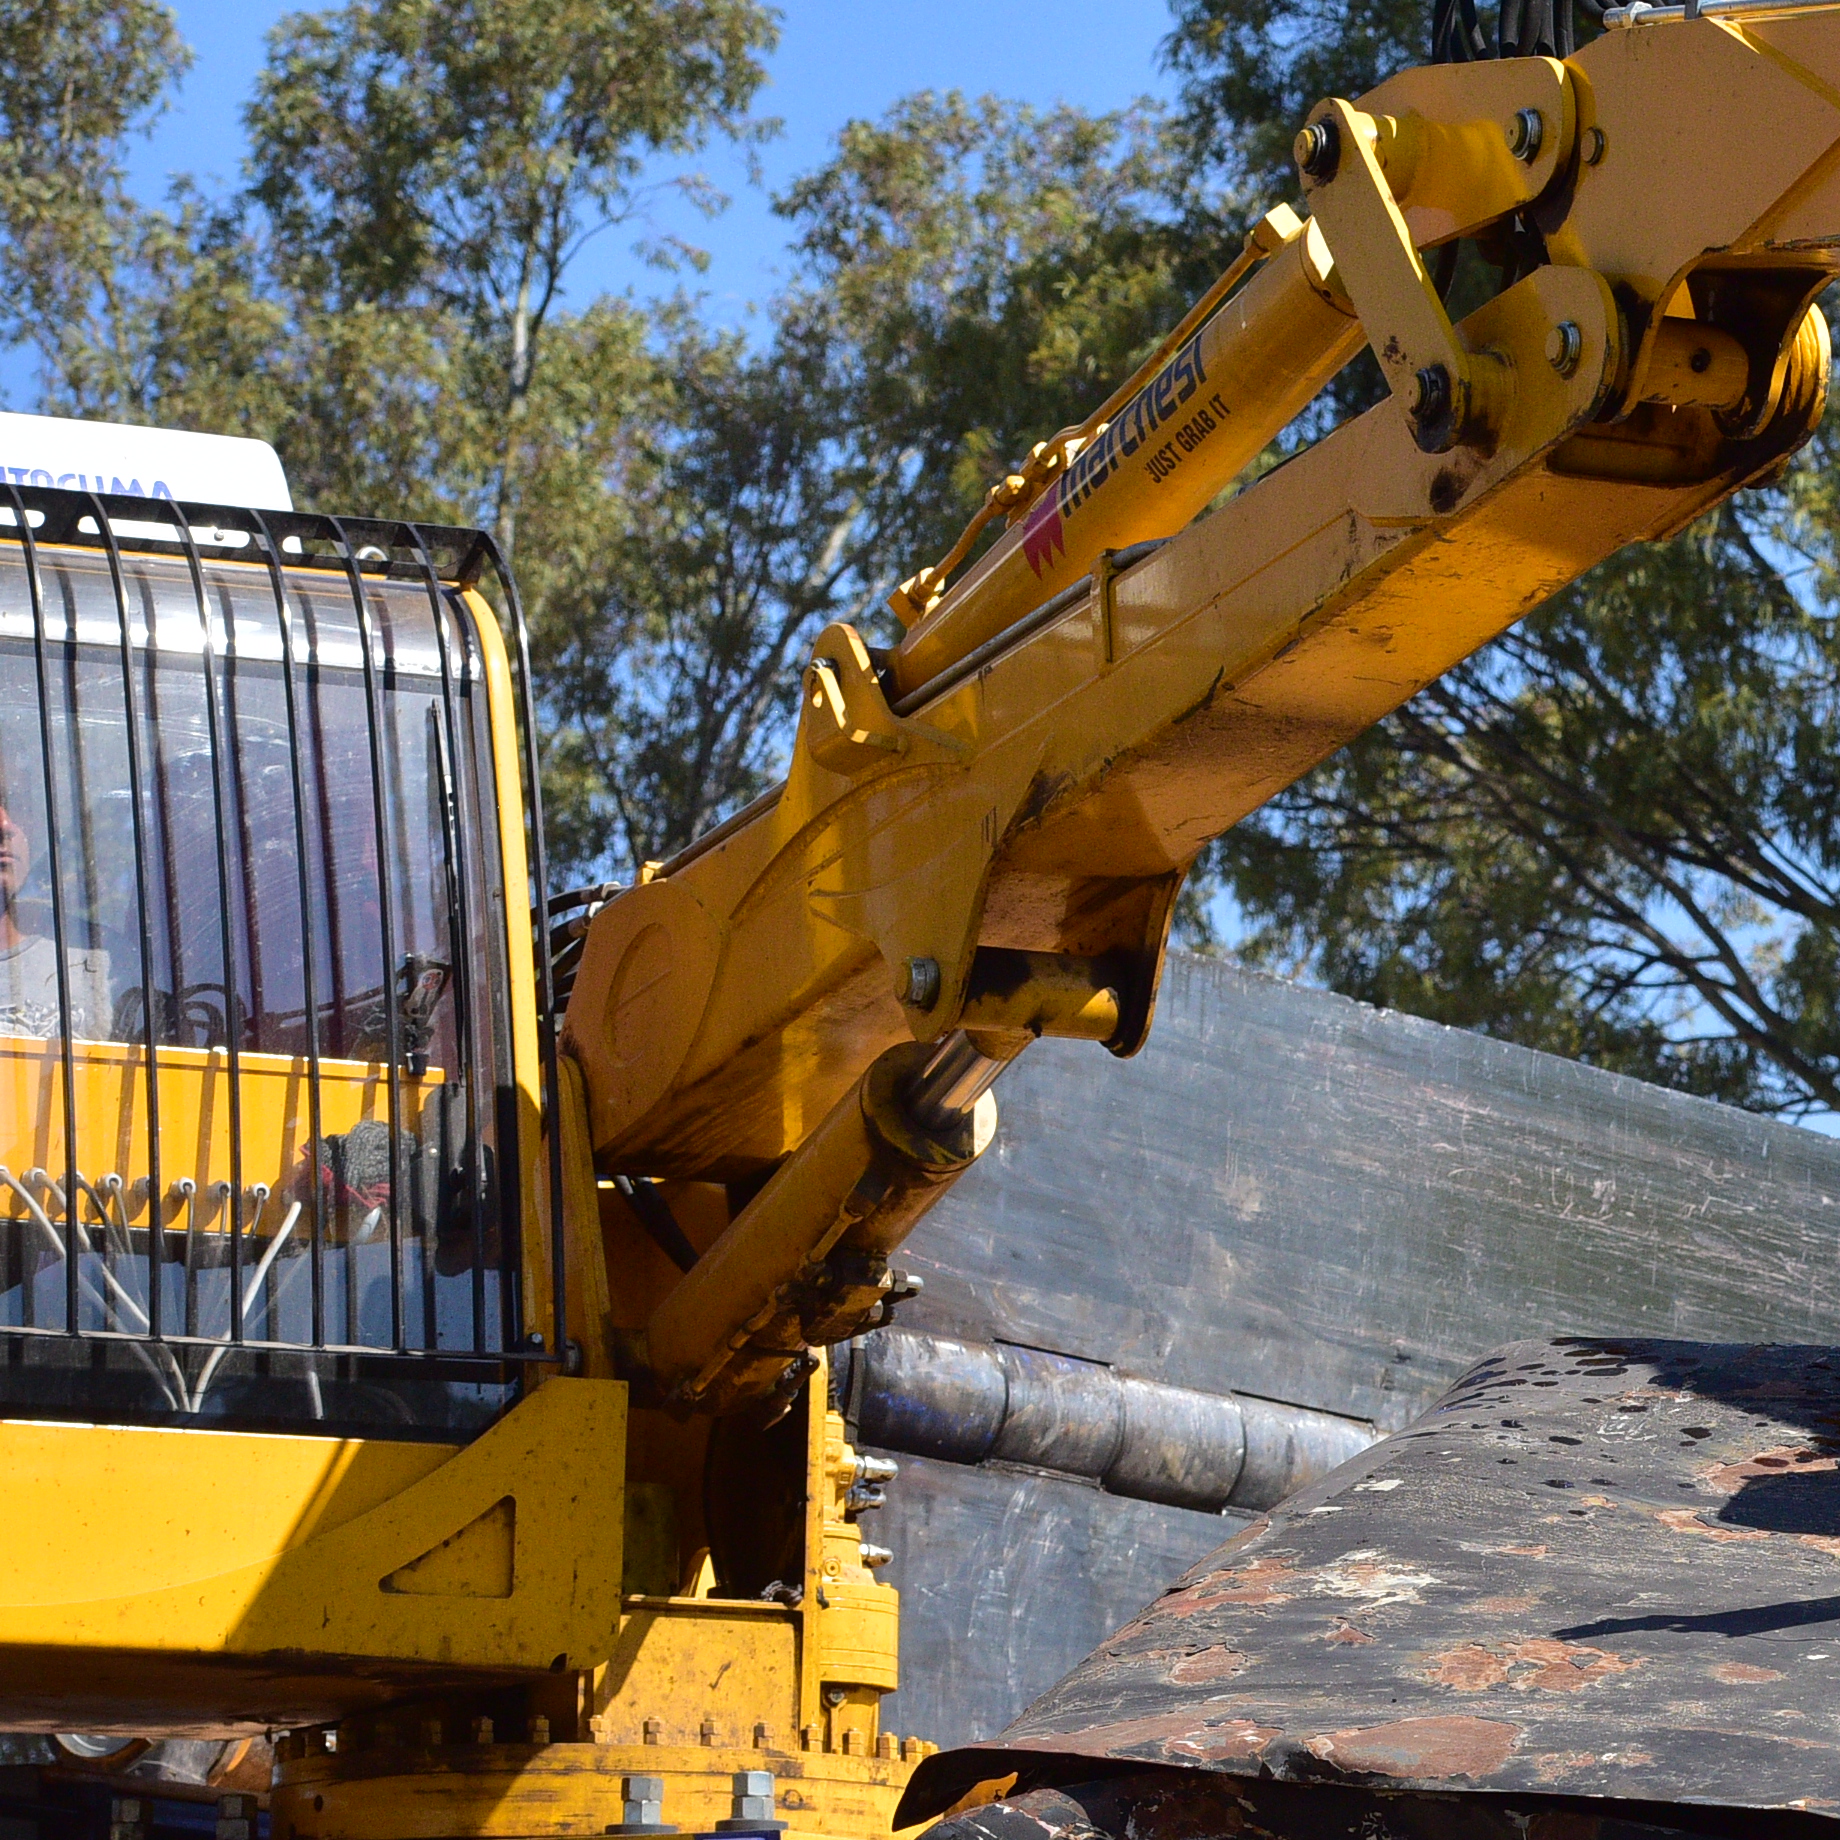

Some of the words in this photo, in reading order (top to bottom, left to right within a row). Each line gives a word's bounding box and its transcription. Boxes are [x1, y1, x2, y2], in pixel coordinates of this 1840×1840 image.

[1144, 441, 1183, 484] JUST
[1175, 408, 1217, 453] GRAB
[1208, 393, 1231, 420] IT
